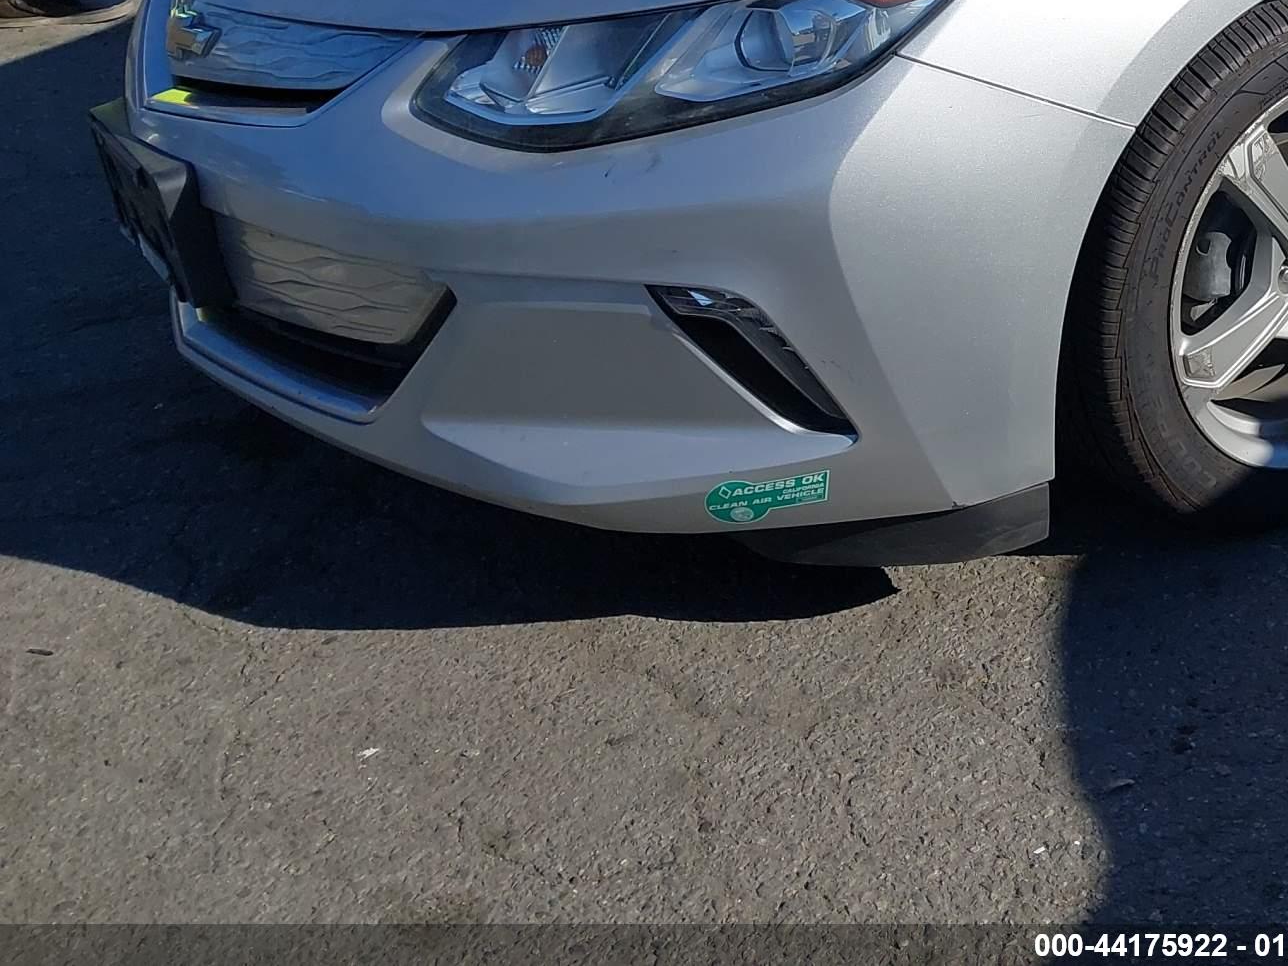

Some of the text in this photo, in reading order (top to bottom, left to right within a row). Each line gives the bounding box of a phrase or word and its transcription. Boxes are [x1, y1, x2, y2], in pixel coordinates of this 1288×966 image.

[732, 473, 825, 497] ACCESS OK
[782, 483, 825, 494] CALIFORNIA
[708, 500, 748, 511] CLEAN
[752, 496, 773, 506] AIR
[776, 487, 825, 501] VEHICLE
